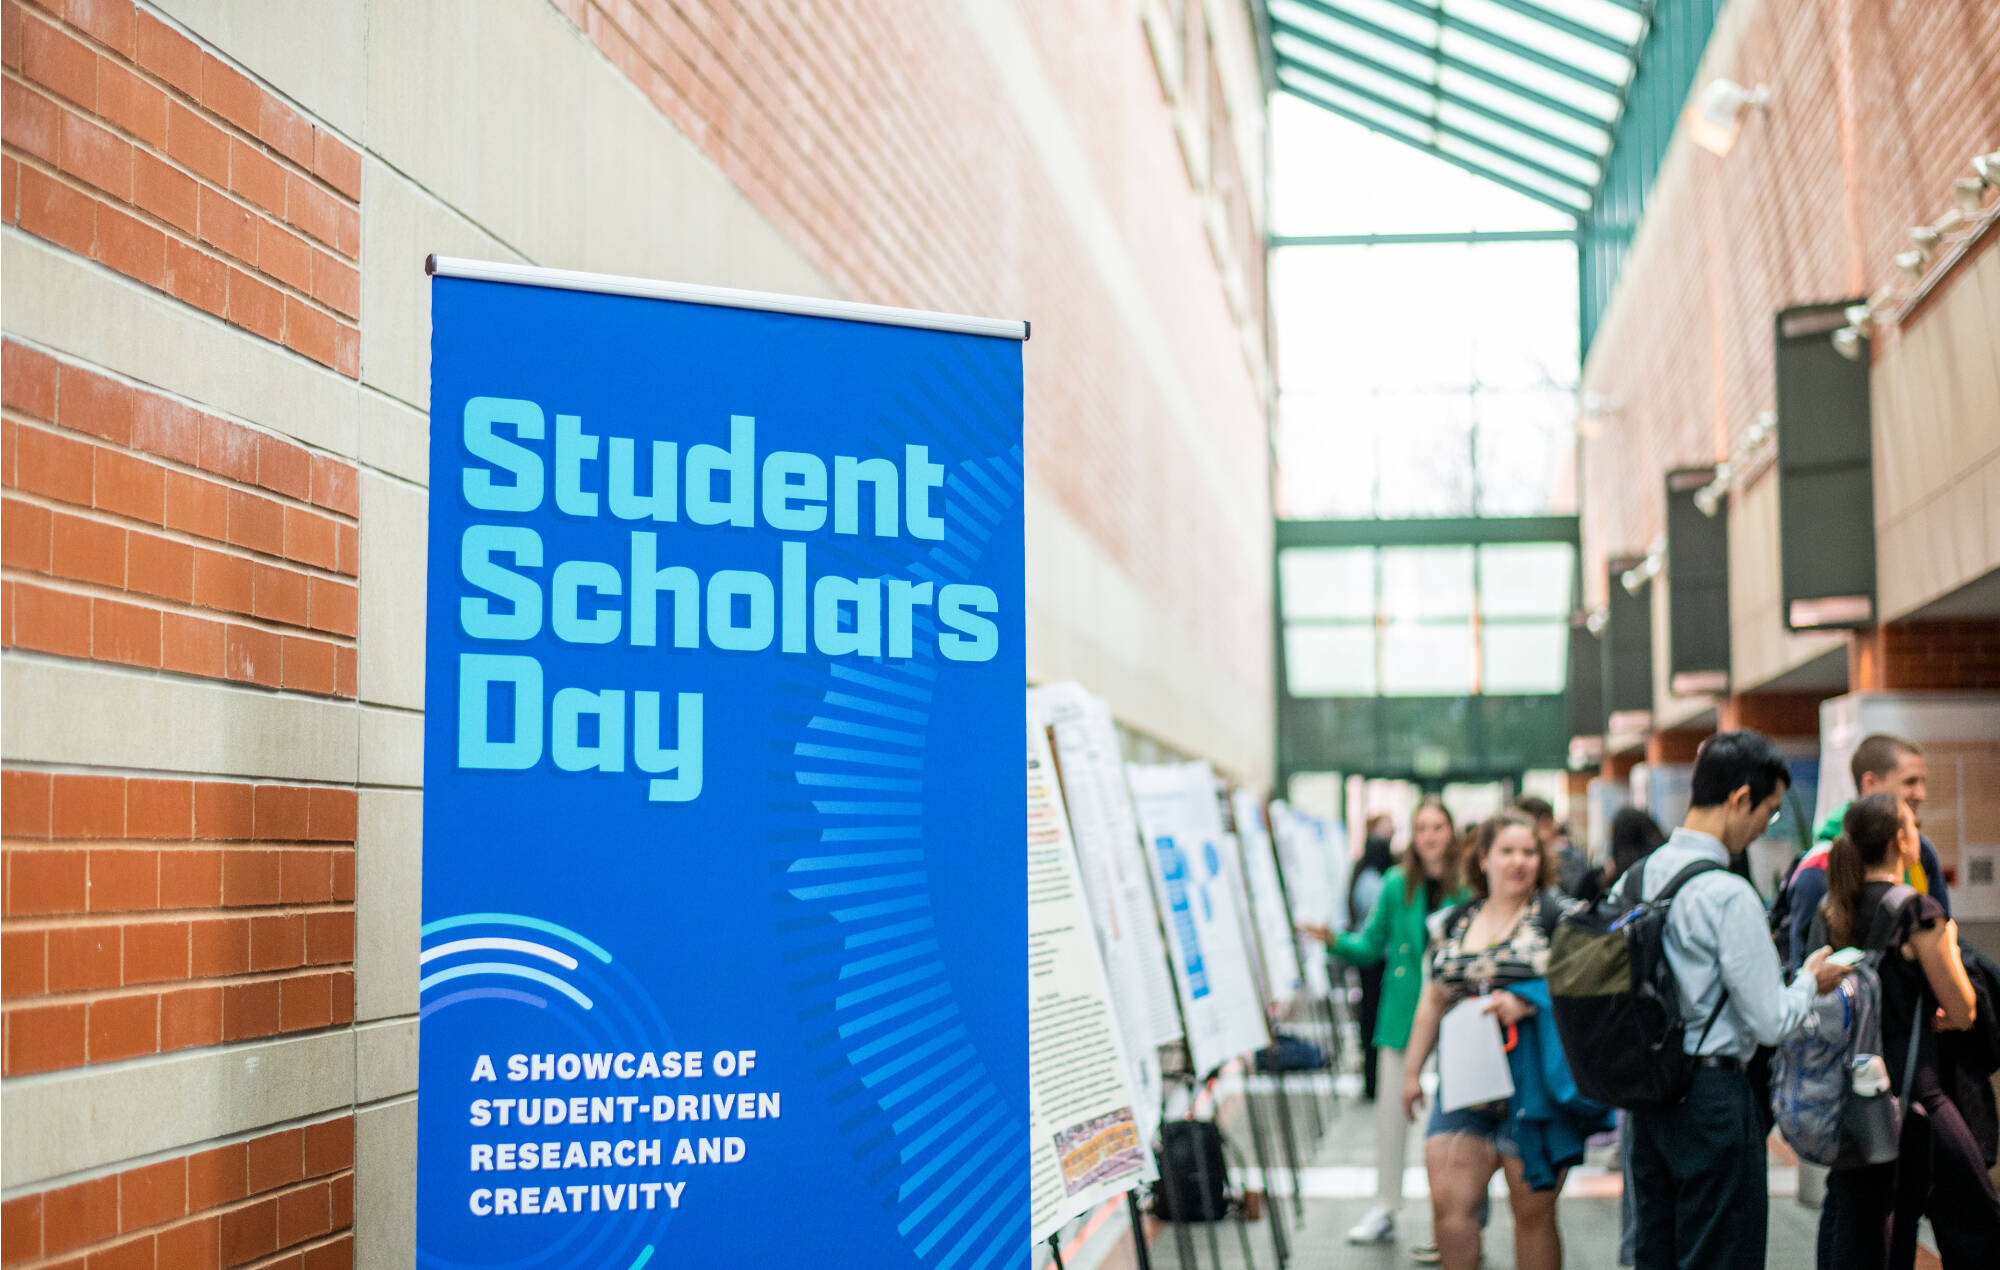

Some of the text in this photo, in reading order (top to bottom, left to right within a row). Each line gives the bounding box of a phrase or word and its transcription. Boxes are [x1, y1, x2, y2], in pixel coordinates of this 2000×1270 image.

[463, 396, 945, 541] Student
[460, 524, 999, 662] Scholars
[458, 653, 704, 802] Day
[470, 1050, 757, 1082] A SHOWCASE OF
[469, 1092, 781, 1127] STUDENT-DRIVEN
[470, 1136, 746, 1172] RESEARCH AND
[469, 1181, 687, 1217] CREATIVITY
